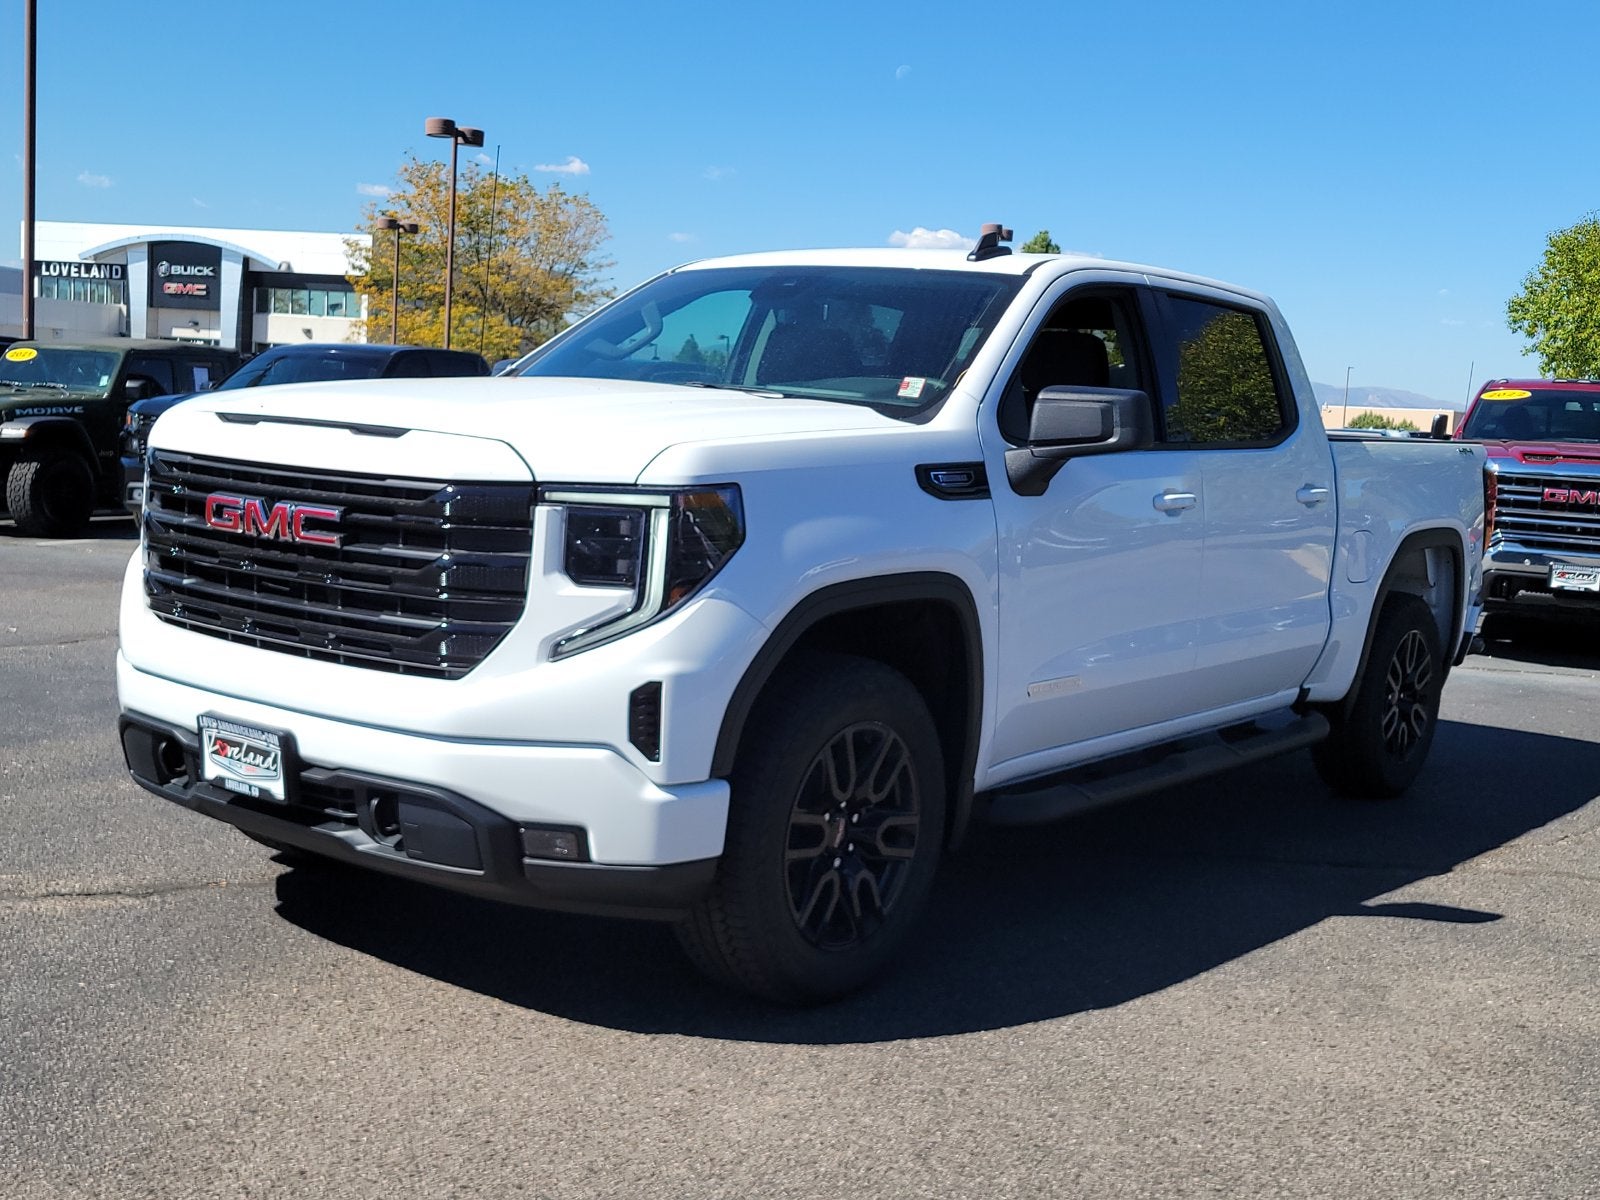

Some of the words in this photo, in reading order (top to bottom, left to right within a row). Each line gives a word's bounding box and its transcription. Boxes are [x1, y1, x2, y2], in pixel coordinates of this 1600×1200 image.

[41, 261, 122, 279] LOVELAND
[171, 264, 216, 277] BUICK
[163, 282, 207, 296] GMC
[15, 406, 84, 416] MOJAVE
[1543, 487, 1600, 505] GM
[205, 491, 344, 549] GMC
